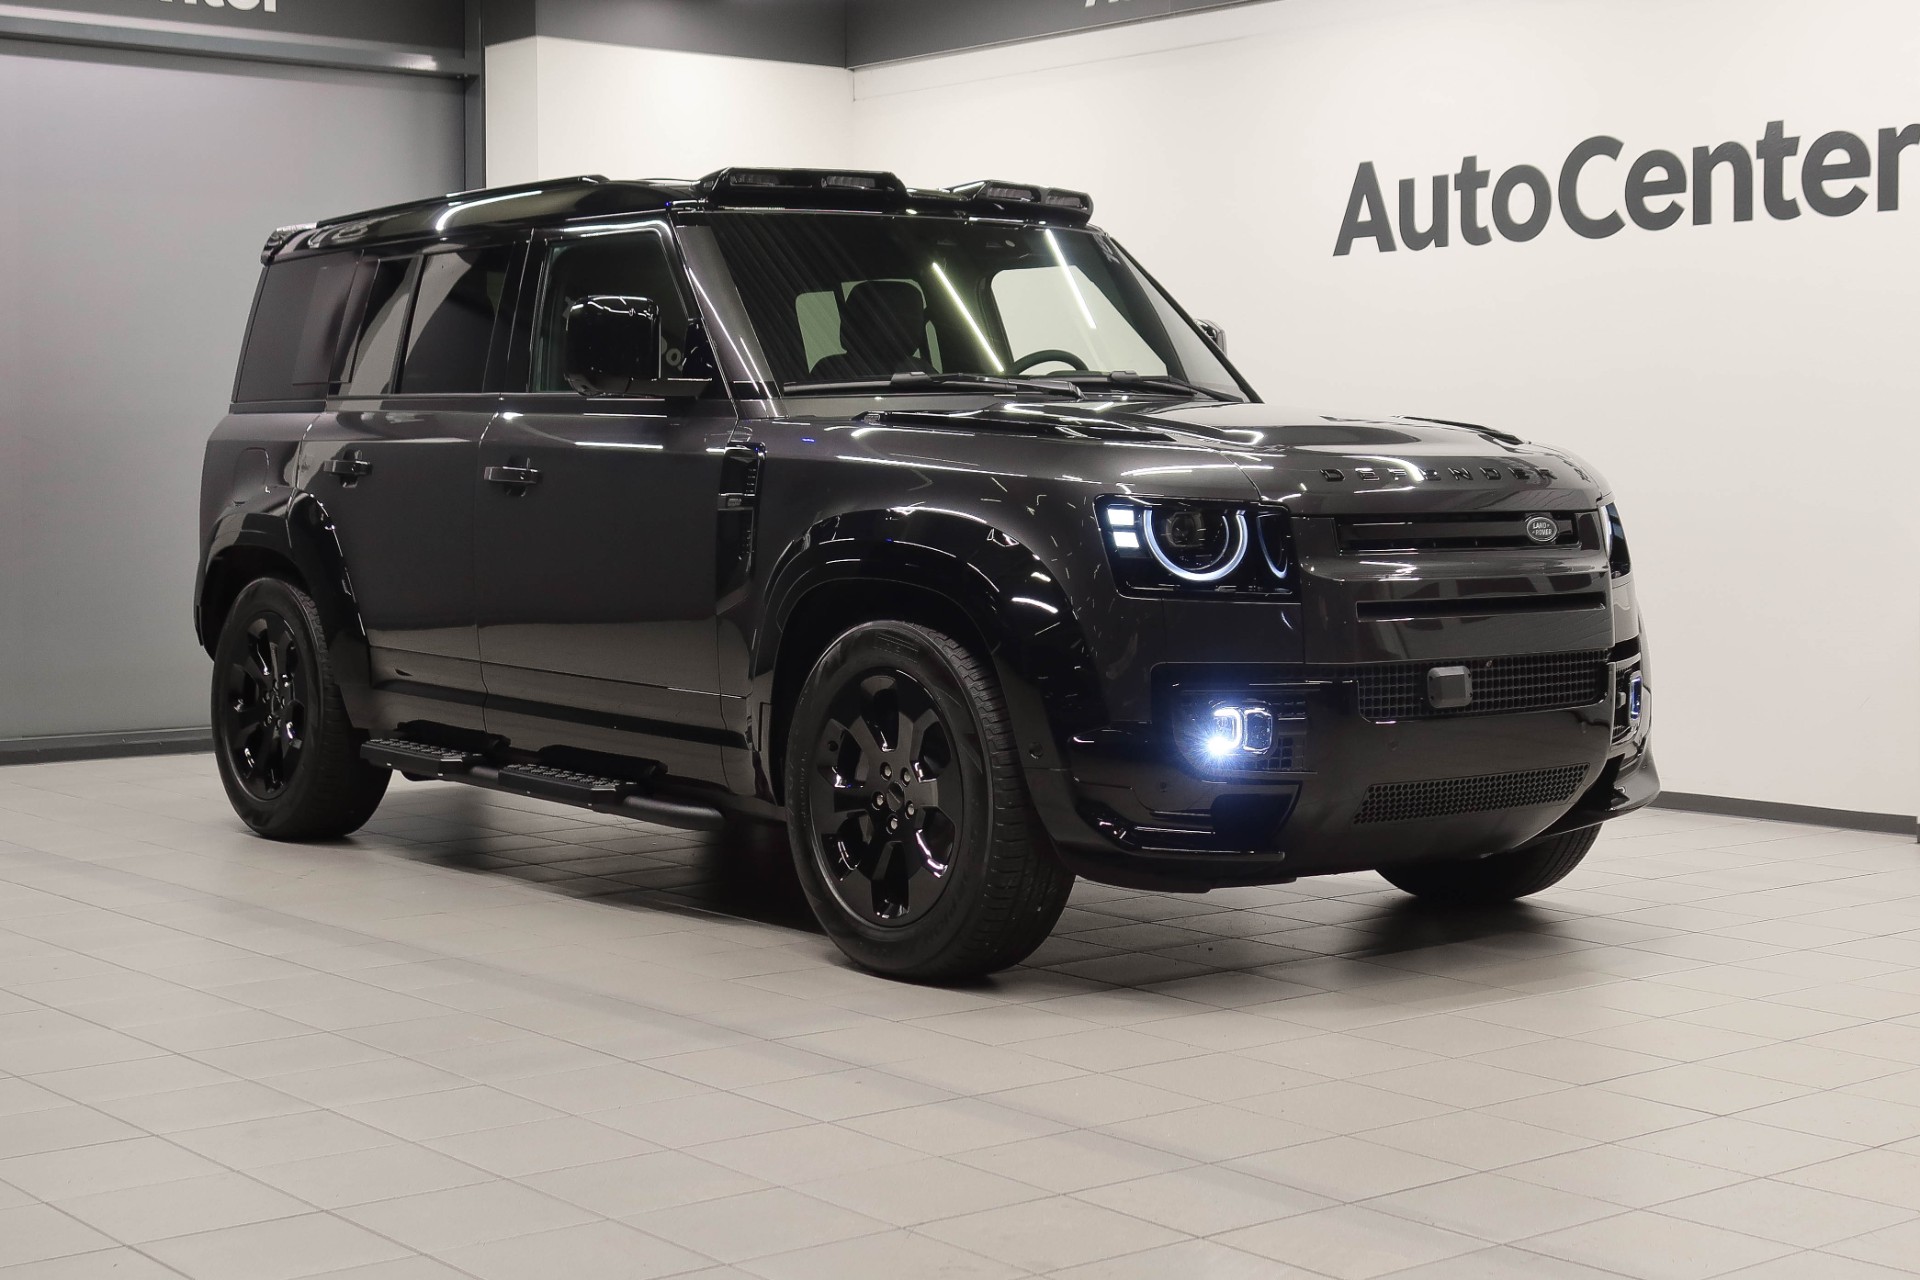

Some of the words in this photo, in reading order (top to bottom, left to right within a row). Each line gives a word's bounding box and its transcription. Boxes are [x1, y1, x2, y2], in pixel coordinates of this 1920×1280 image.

[1332, 119, 1920, 257] AutoCenter
[1319, 466, 1558, 483] DEFENDER
[1532, 521, 1547, 530] LAND
[1535, 528, 1553, 536] ROVER
